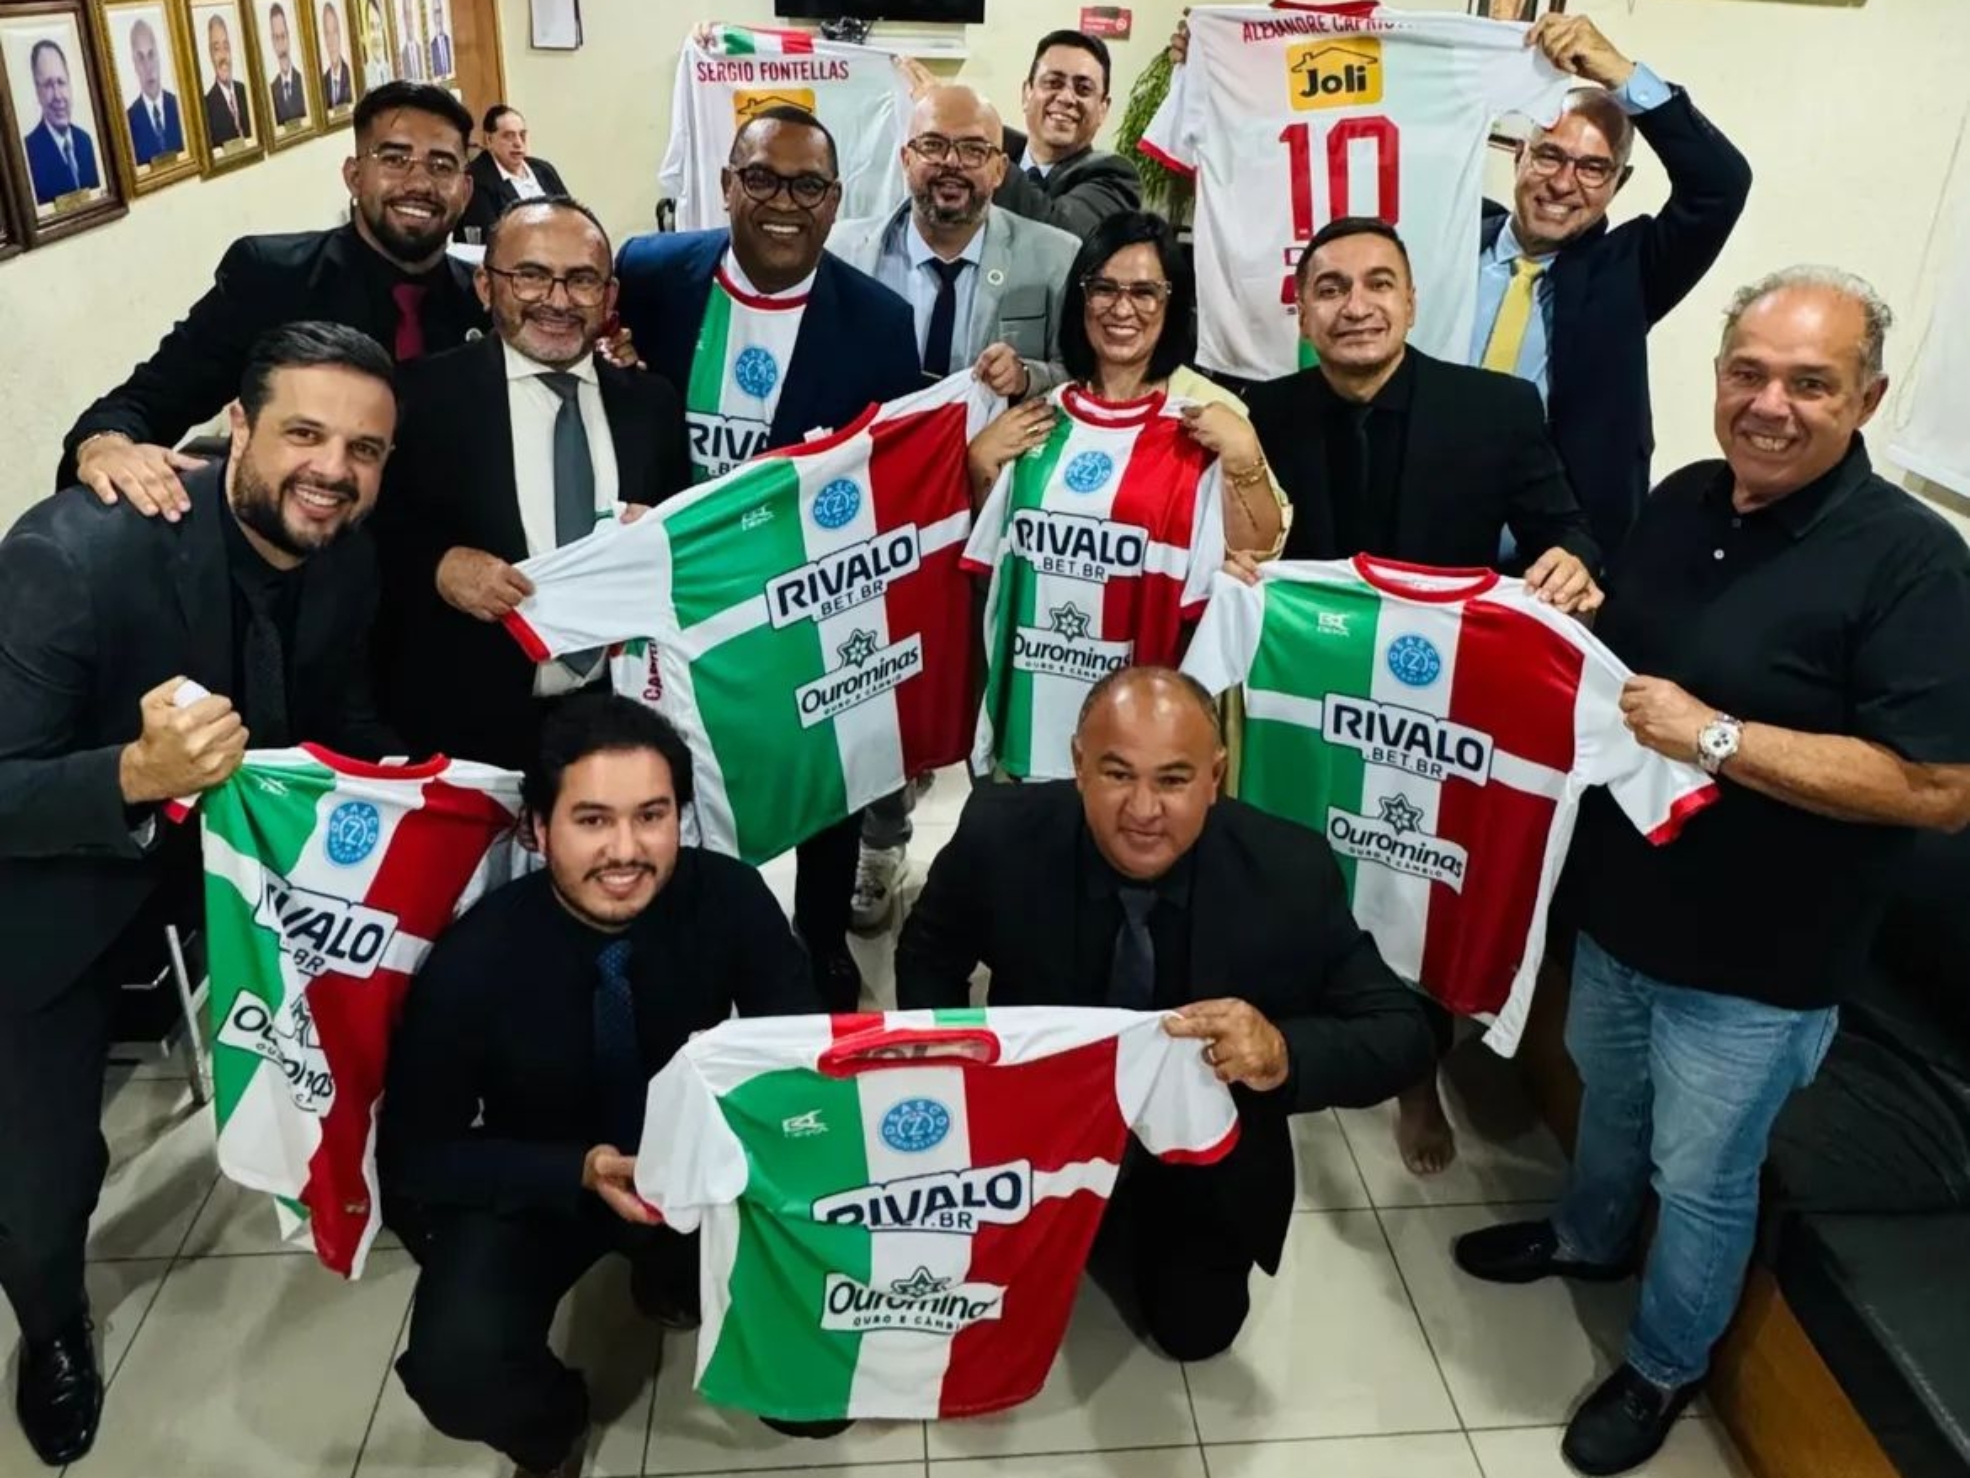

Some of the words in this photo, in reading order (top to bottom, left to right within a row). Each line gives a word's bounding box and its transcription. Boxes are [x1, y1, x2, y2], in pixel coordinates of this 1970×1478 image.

[696, 61, 754, 82] SERGIO
[760, 60, 849, 81] FONTELLAS
[1300, 64, 1366, 97] Joli
[1279, 116, 1399, 241] 10
[687, 421, 770, 461] RIVA
[1016, 518, 1142, 567] RIVALO
[777, 535, 913, 617] RIVALO
[801, 645, 919, 714] Ourominas
[1333, 703, 1484, 772] RIVALO
[1331, 817, 1462, 878] Ourominas
[828, 1281, 1001, 1320] Ouromina
